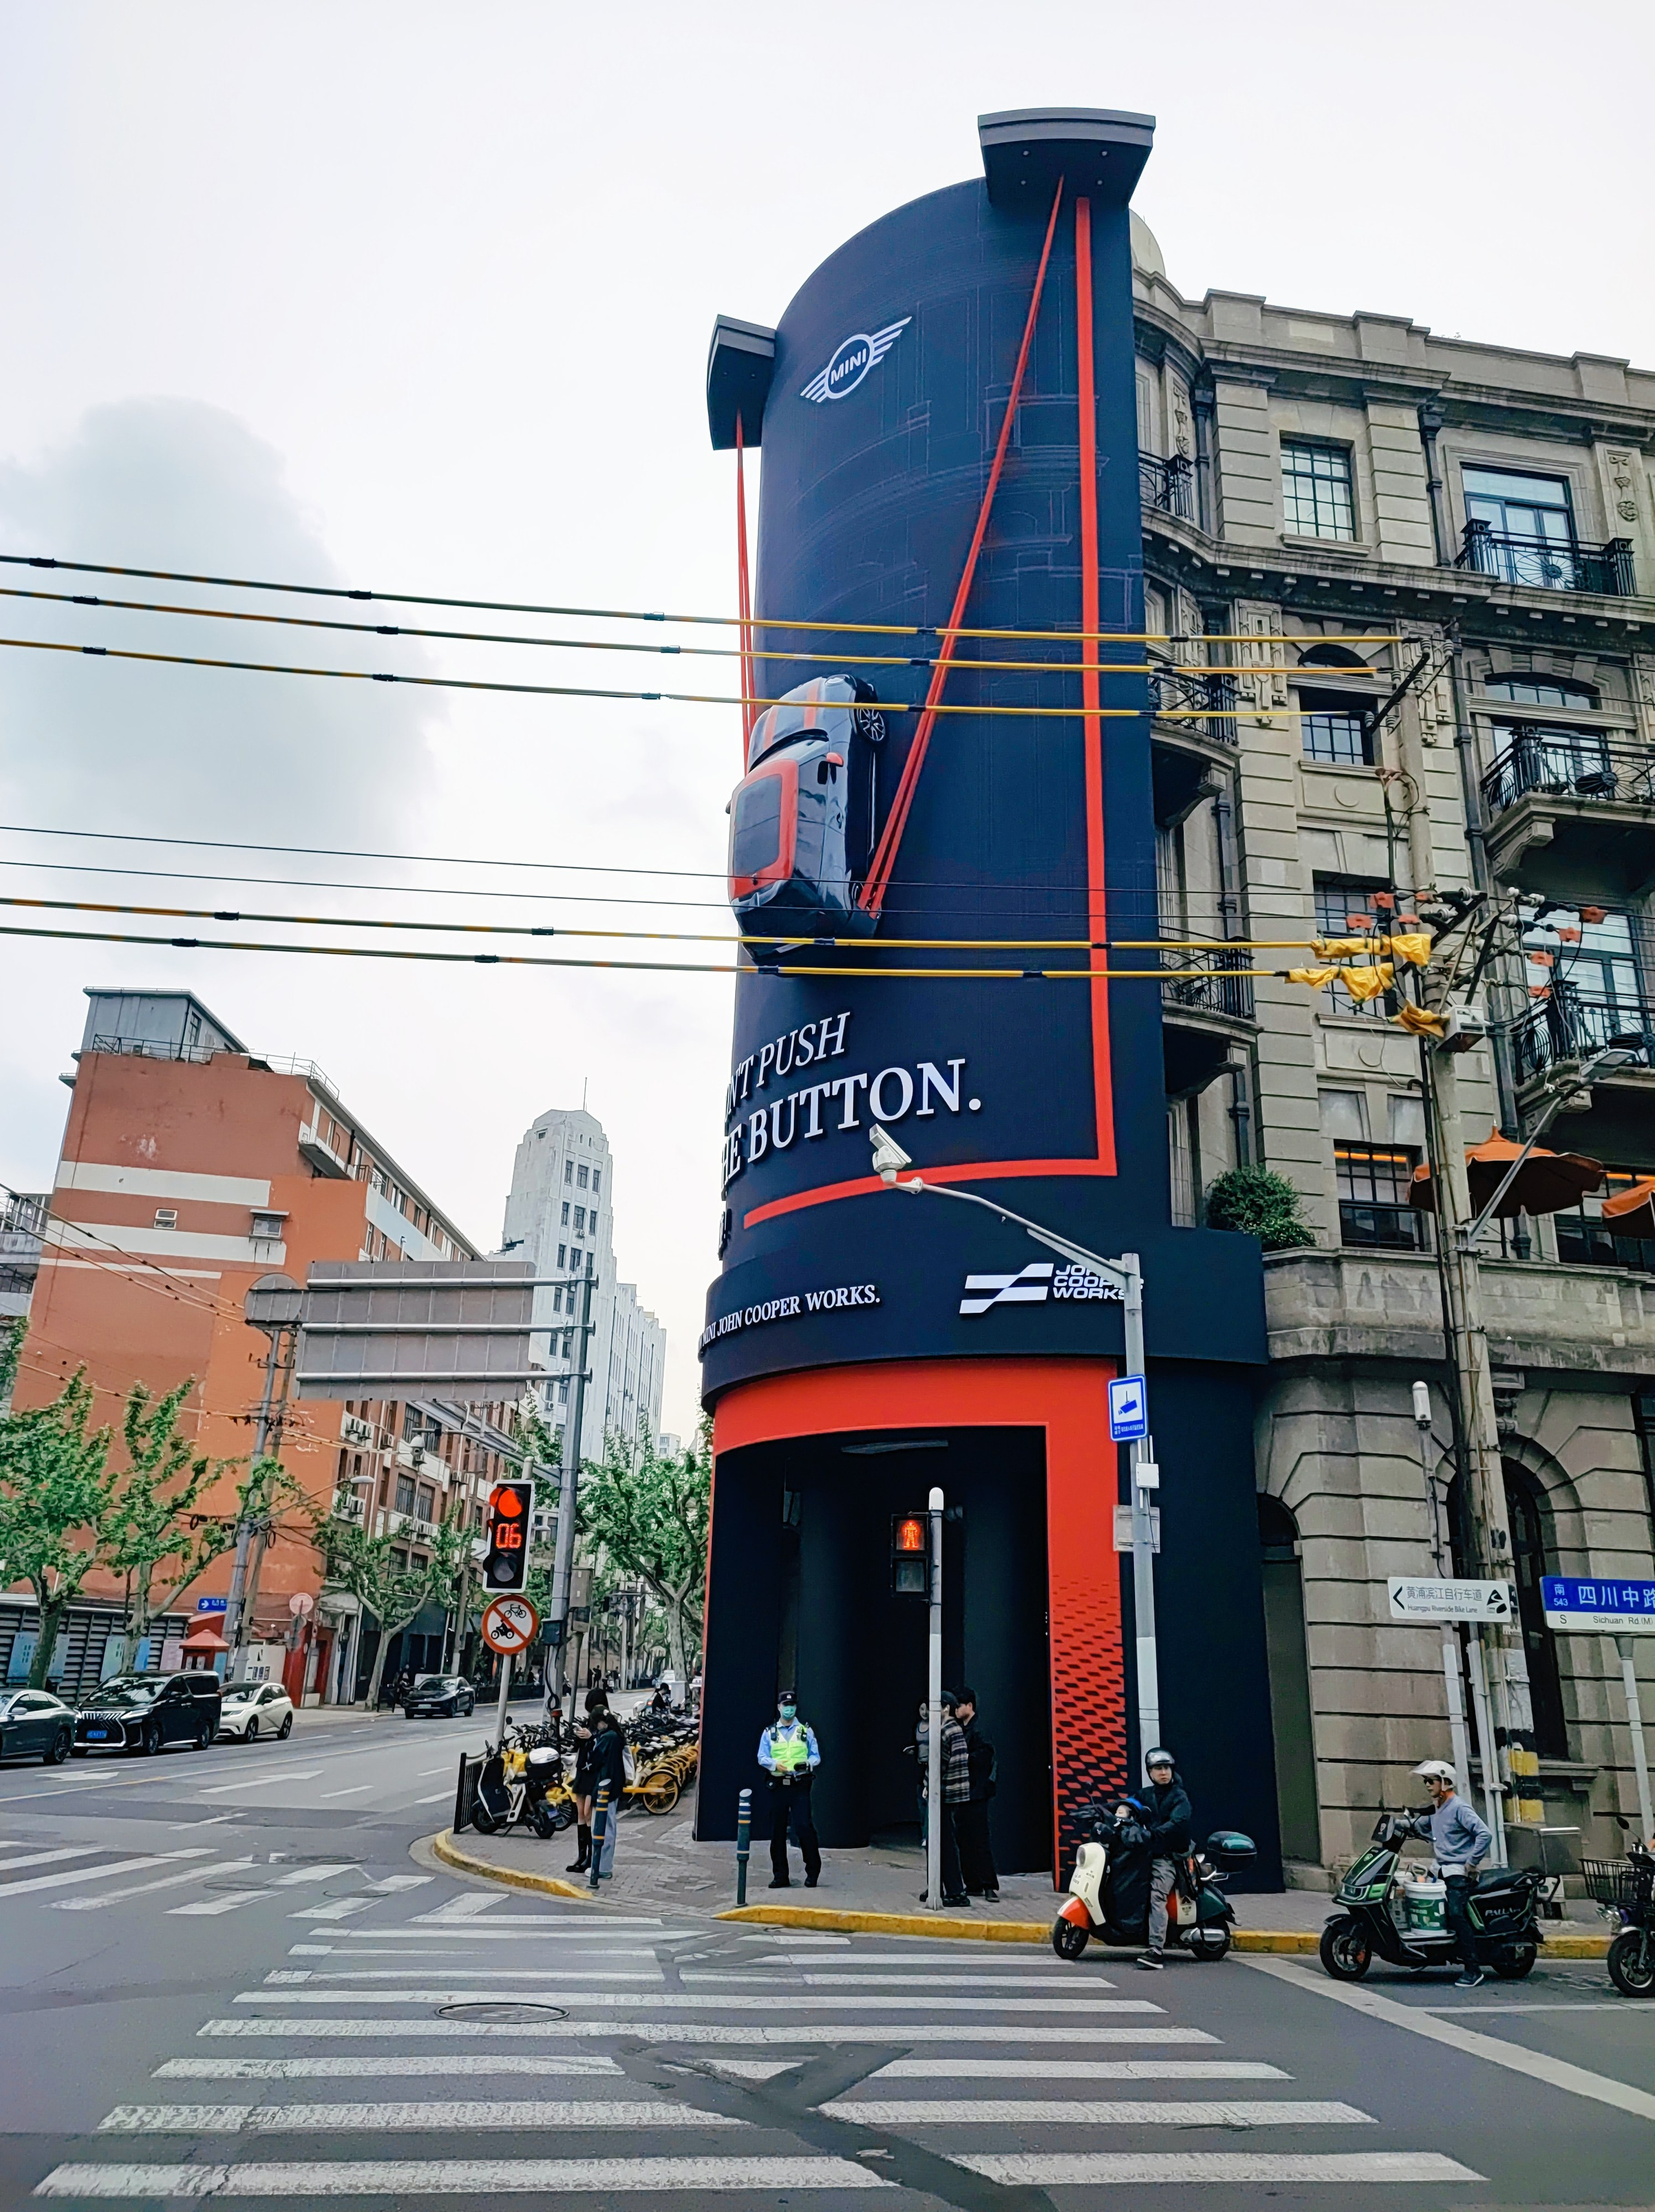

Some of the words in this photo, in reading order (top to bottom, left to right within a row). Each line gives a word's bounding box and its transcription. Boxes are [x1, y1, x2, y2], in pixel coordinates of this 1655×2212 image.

[830, 348, 867, 385] MINI
[756, 1012, 851, 1087] PUSH
[747, 1058, 981, 1163] BUTTON.
[717, 1310, 743, 1336] JOHN
[745, 1295, 801, 1325] COOPER
[805, 1284, 880, 1311] WORKS.
[496, 1523, 522, 1549] 06
[1554, 1584, 1565, 1595] 南
[1578, 1586, 1655, 1608] 四川中路
[1554, 1598, 1568, 1606] 543
[1560, 1615, 1567, 1624] S
[1593, 1615, 1623, 1624] Sichuan
